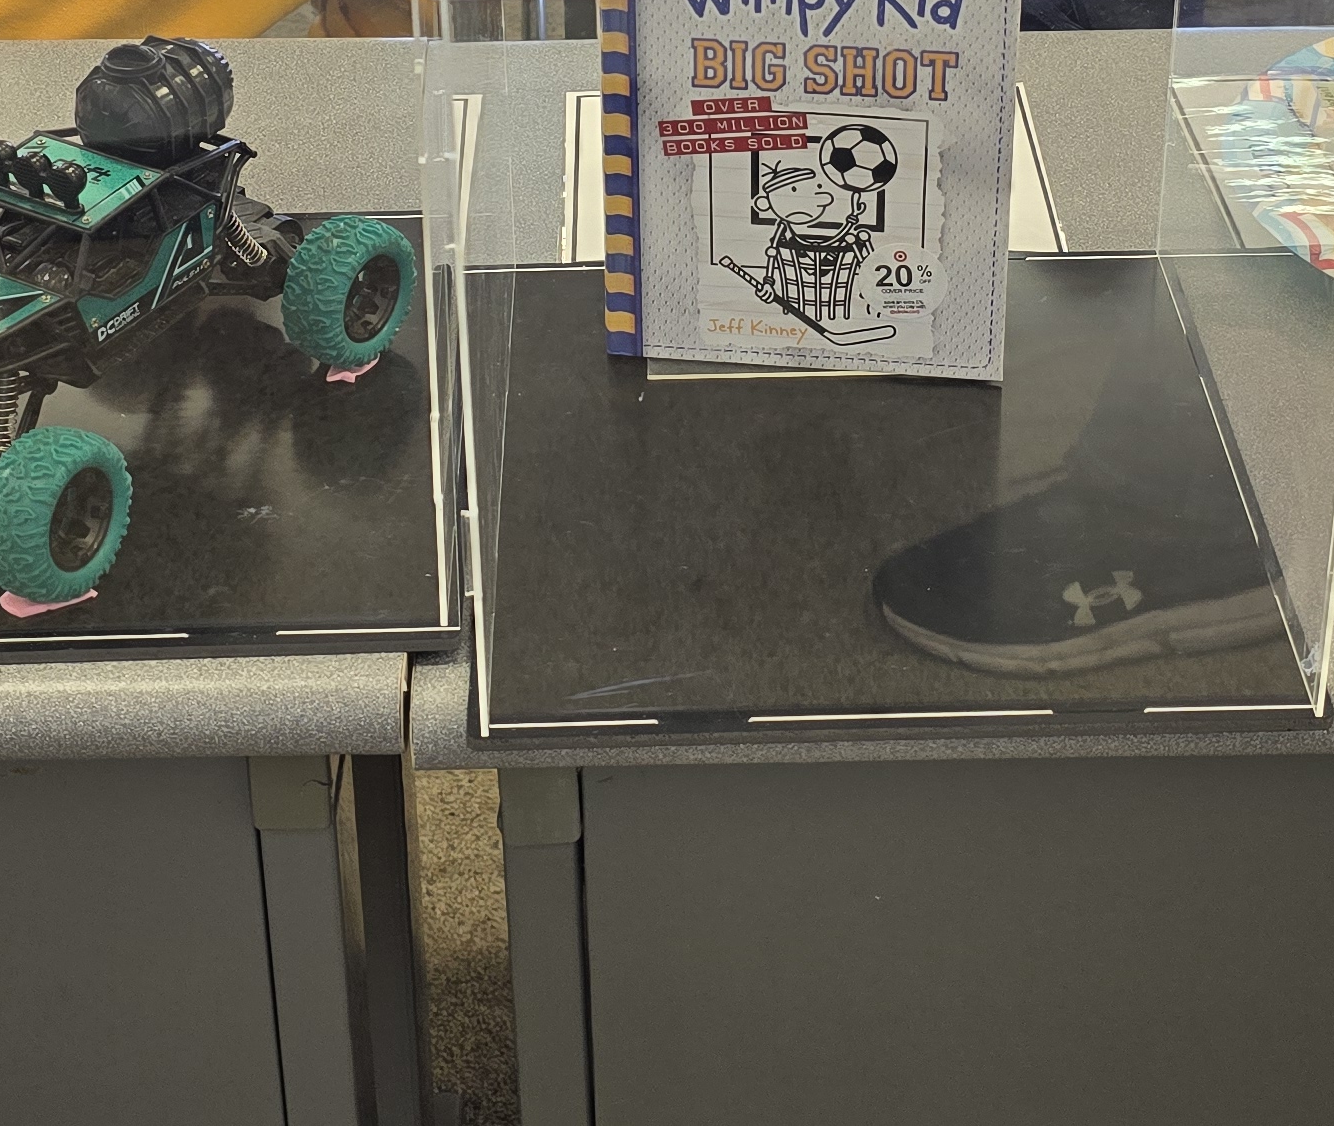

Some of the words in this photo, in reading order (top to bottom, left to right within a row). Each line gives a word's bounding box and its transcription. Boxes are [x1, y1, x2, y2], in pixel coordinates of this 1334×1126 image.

[691, 37, 787, 93] BIG
[803, 43, 960, 102] SHOT
[703, 99, 760, 113] OVER
[662, 121, 705, 134] 300
[717, 115, 804, 131] MILLION
[666, 139, 735, 153] BOOKS
[748, 136, 803, 149] SOLD
[706, 317, 745, 334] Jeff
[750, 318, 808, 346] Kinney
